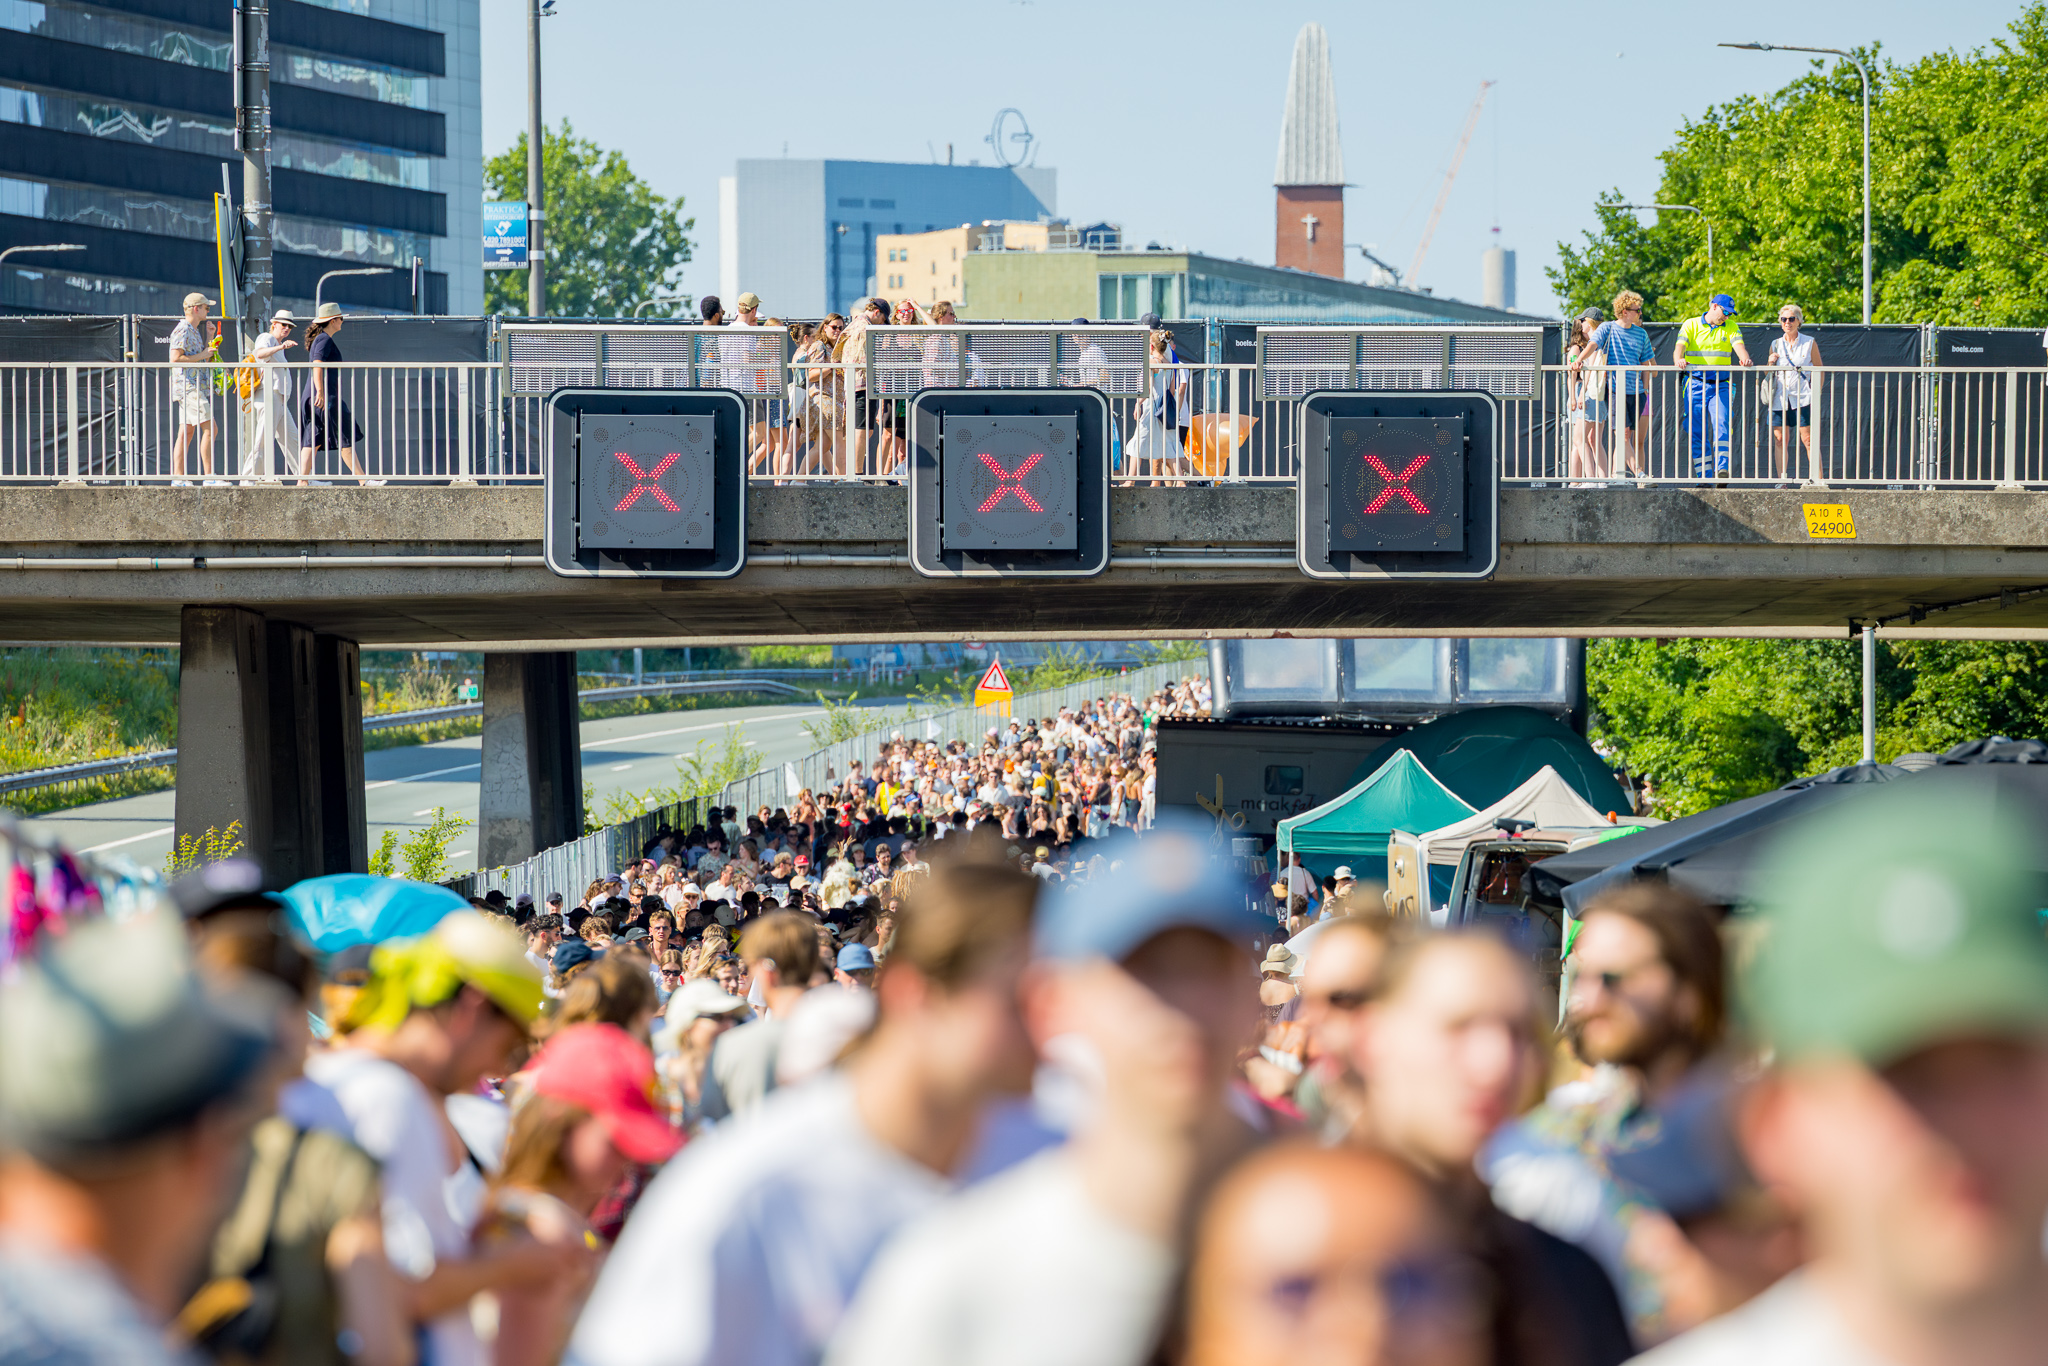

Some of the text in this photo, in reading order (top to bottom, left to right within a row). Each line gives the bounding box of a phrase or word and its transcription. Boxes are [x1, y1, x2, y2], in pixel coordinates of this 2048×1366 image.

[484, 205, 524, 214] PRAKTICA
[1951, 345, 1984, 353] boels.com
[1836, 508, 1844, 518] R
